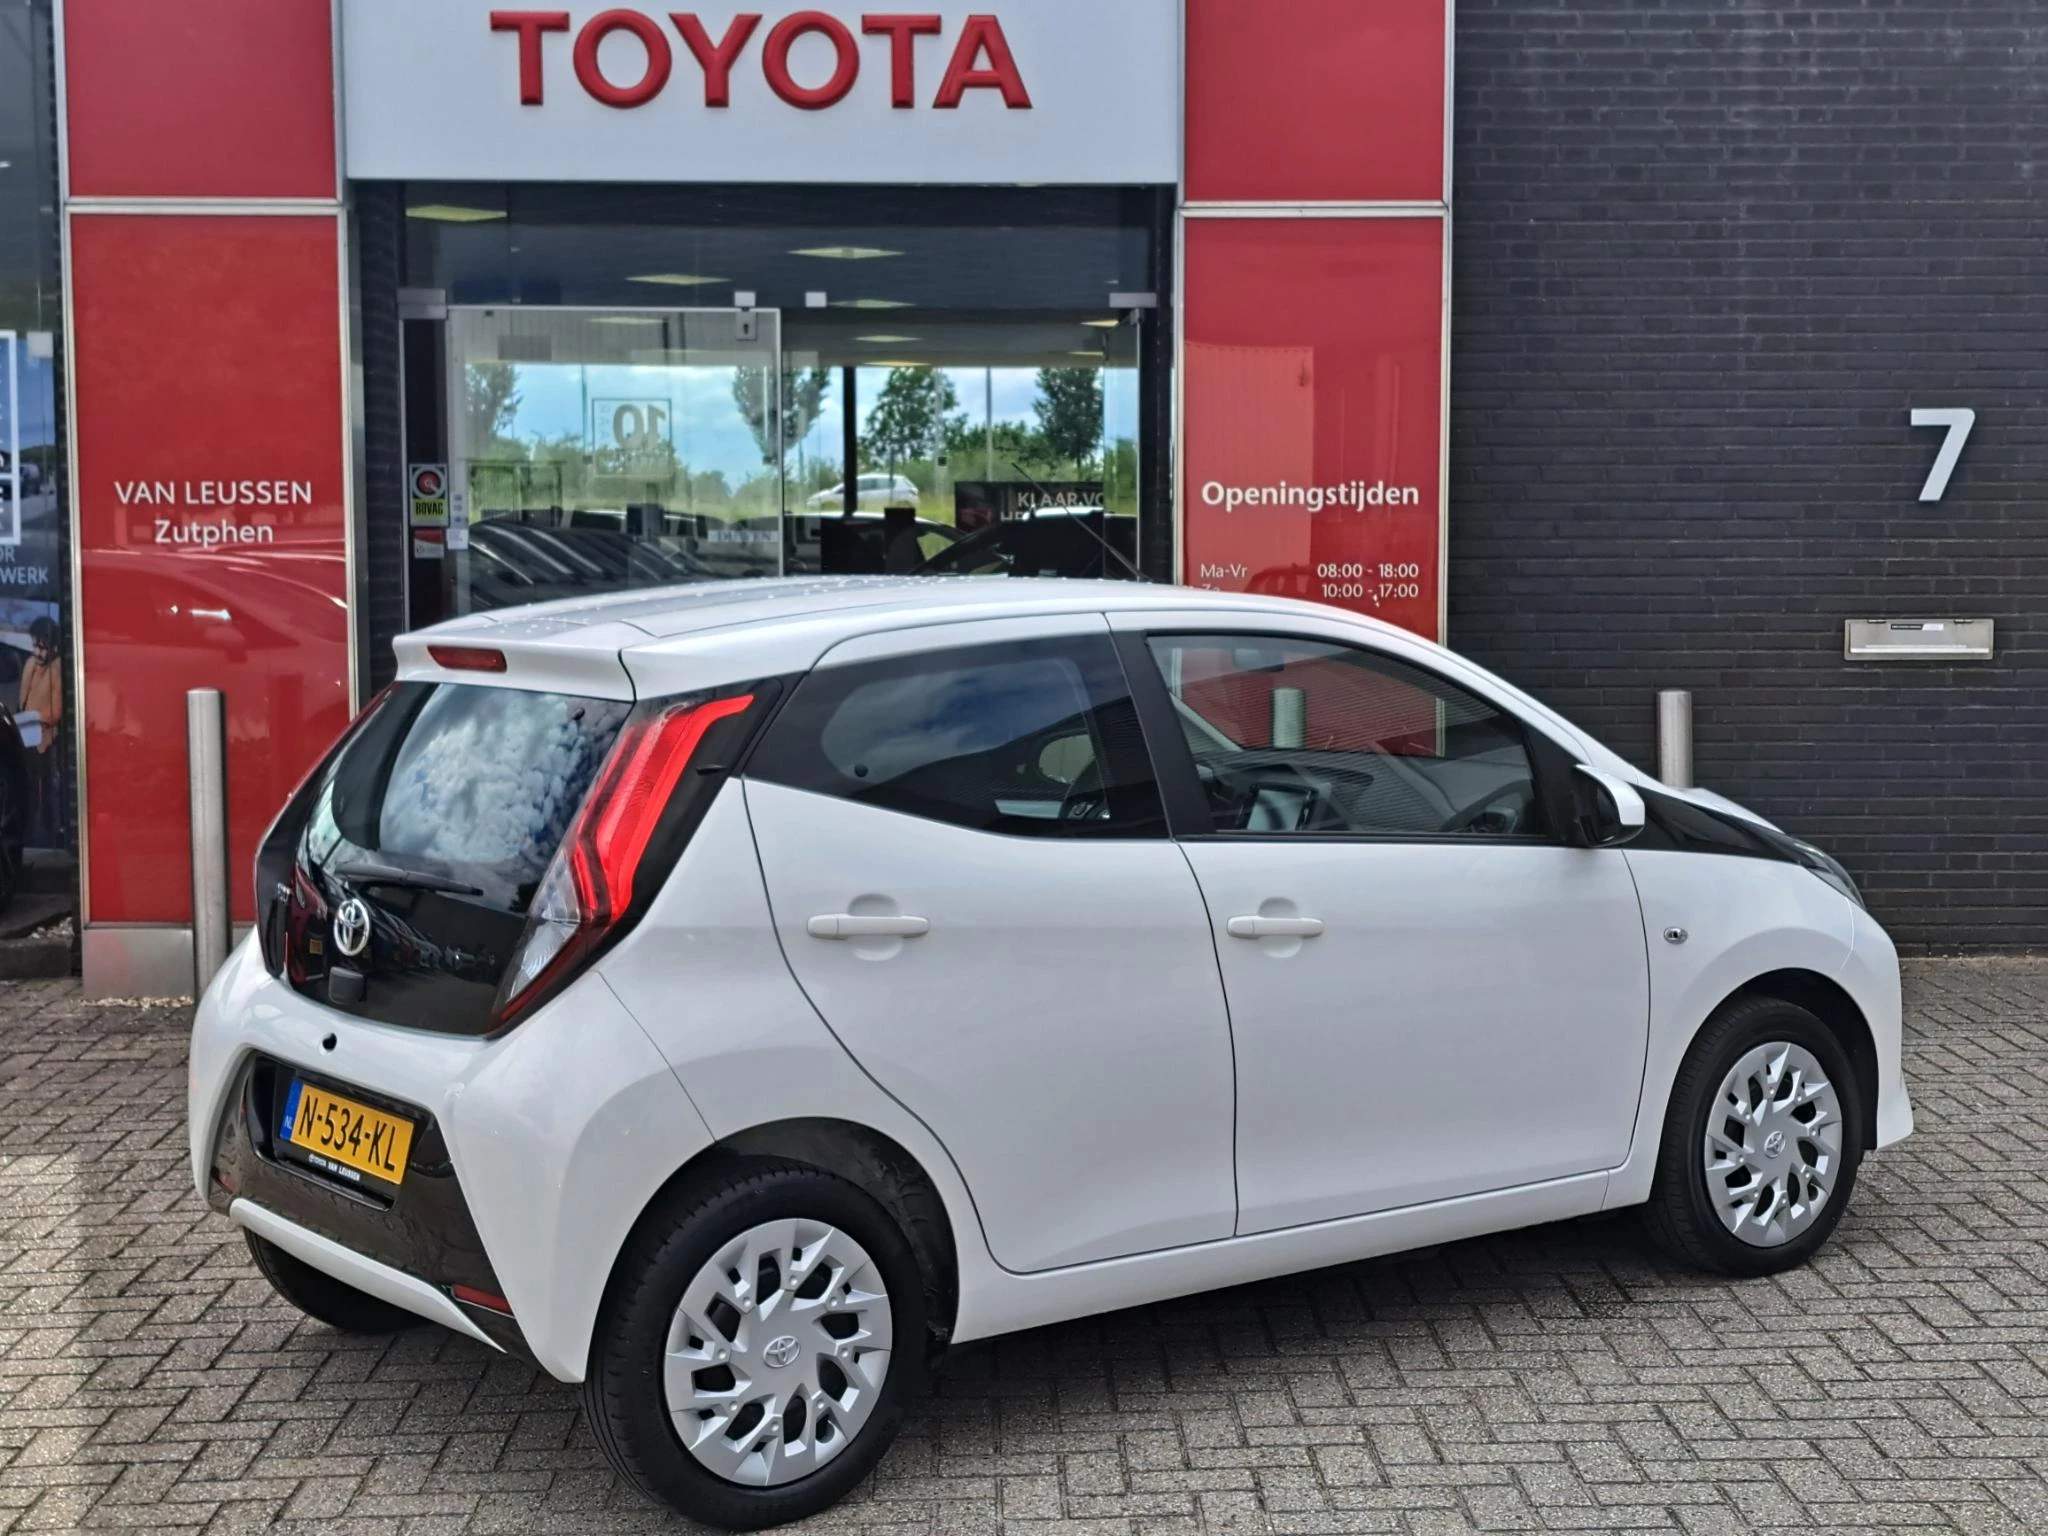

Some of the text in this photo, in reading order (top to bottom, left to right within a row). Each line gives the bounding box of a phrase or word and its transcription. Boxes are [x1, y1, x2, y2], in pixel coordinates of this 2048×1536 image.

[490, 8, 1033, 110] TOYOTA
[1910, 408, 1976, 501] 7
[114, 480, 312, 504] VAN LEUSSEN
[1201, 481, 1419, 513] Openingstijden
[154, 519, 273, 549] Zutphen
[1200, 563, 1247, 578] Ma-Vr
[1317, 563, 1363, 578] 08:00
[1378, 563, 1419, 578] 18:00
[1322, 583, 1363, 598] 10:00
[1378, 583, 1419, 598] 17:00
[284, 1115, 293, 1130] NL
[299, 1094, 395, 1172] N-534-KL
